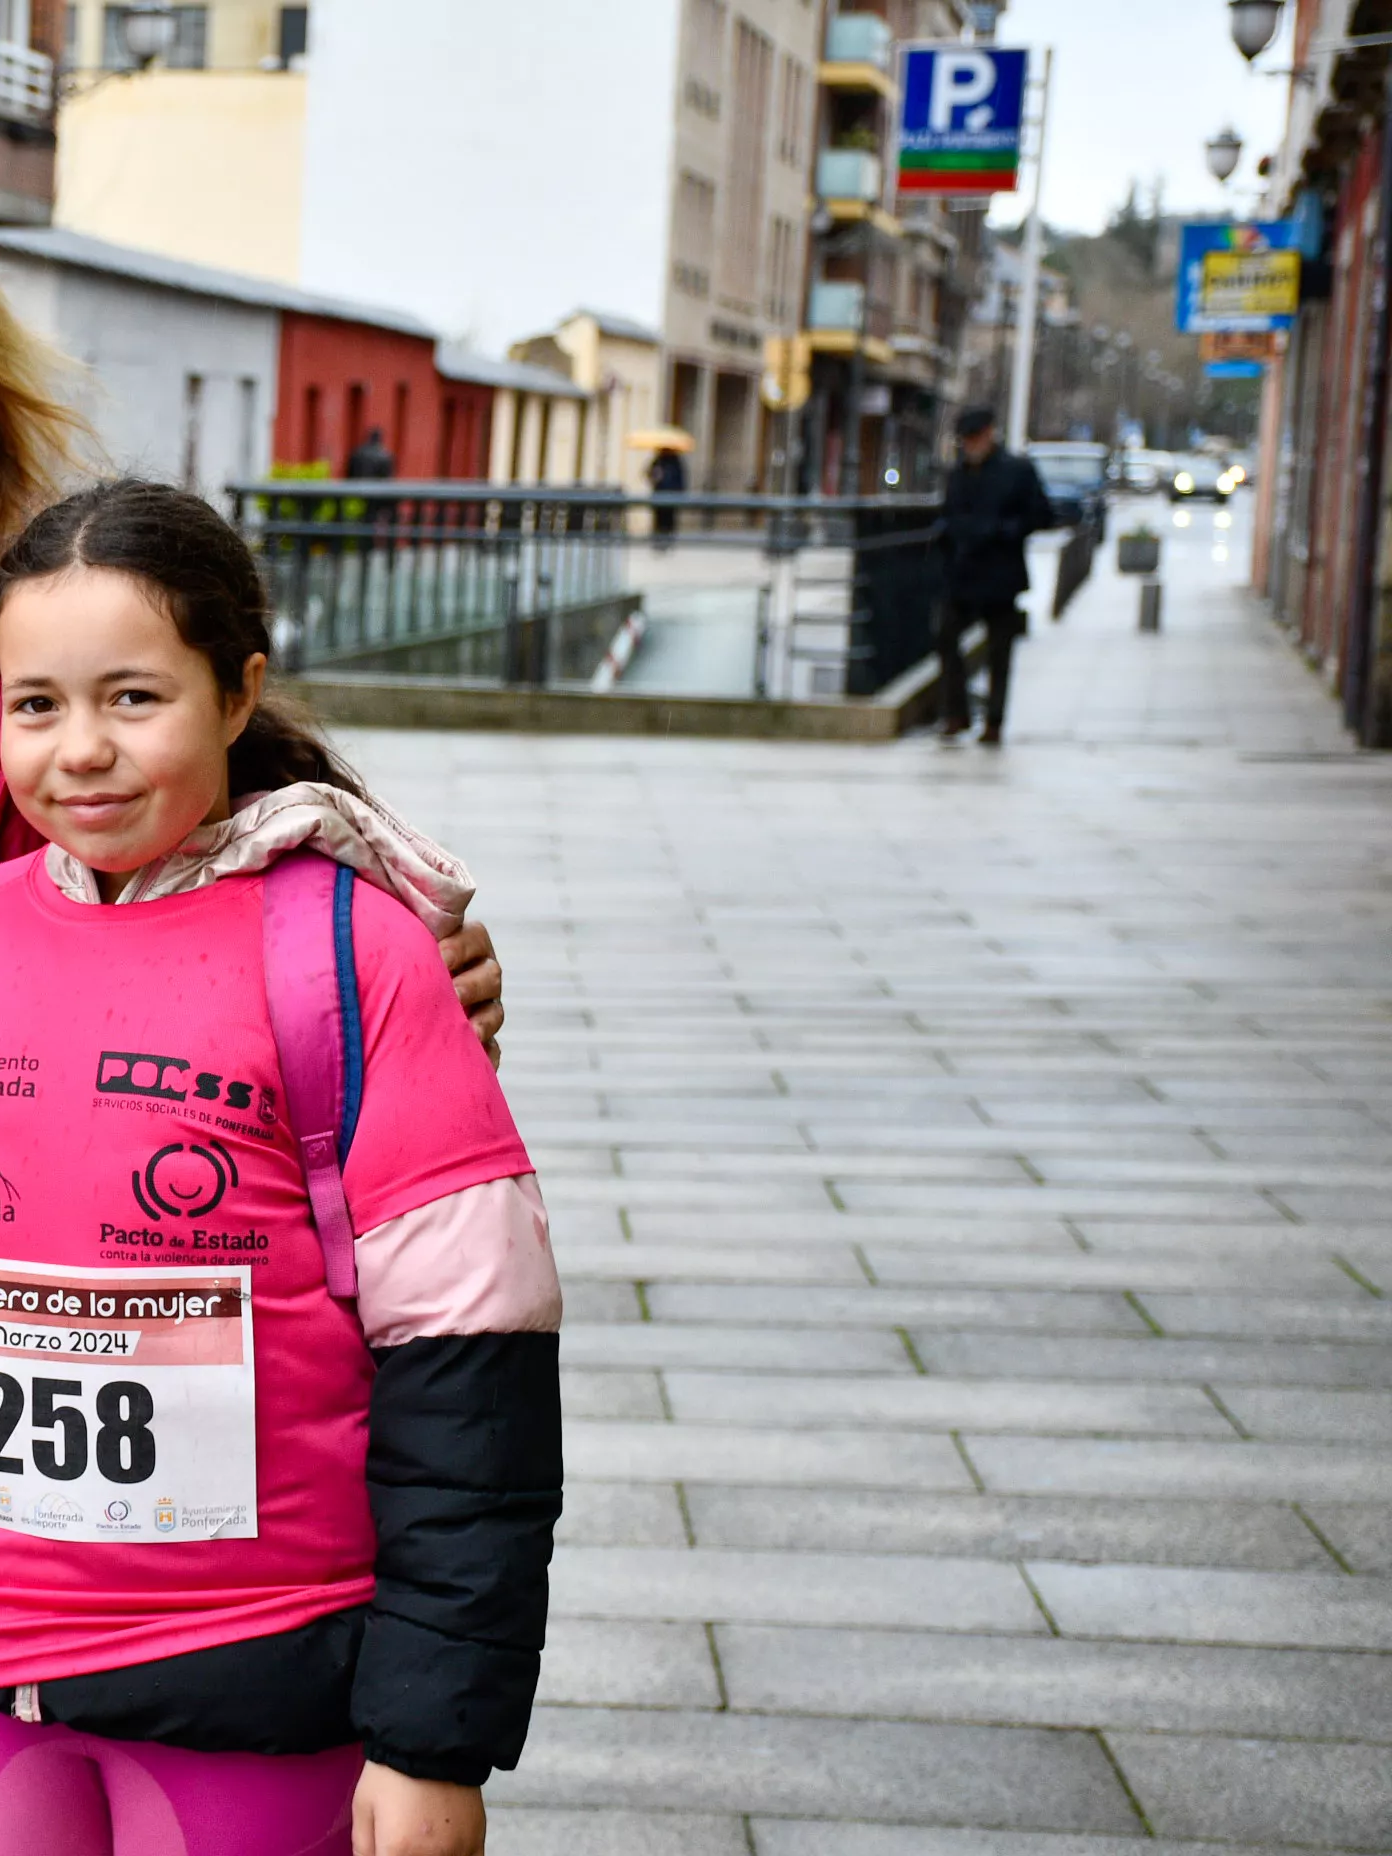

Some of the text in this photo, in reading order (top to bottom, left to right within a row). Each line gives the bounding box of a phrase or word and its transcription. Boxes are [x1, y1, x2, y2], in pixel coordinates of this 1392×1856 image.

[929, 52, 997, 133] P
[92, 1098, 143, 1112] SERVICIOS
[145, 1102, 197, 1121] SOCIALES
[199, 1111, 212, 1125] DE
[99, 1223, 270, 1251] Pacto de Estado
[99, 1250, 138, 1262] contra
[140, 1250, 151, 1263] la
[154, 1251, 208, 1266] violencia
[210, 1253, 225, 1266] de
[46, 1289, 83, 1316] de
[89, 1291, 116, 1318] la
[124, 1291, 222, 1326] mujer
[69, 1330, 129, 1355] 2024
[33, 1506, 84, 1524] Ponferrada
